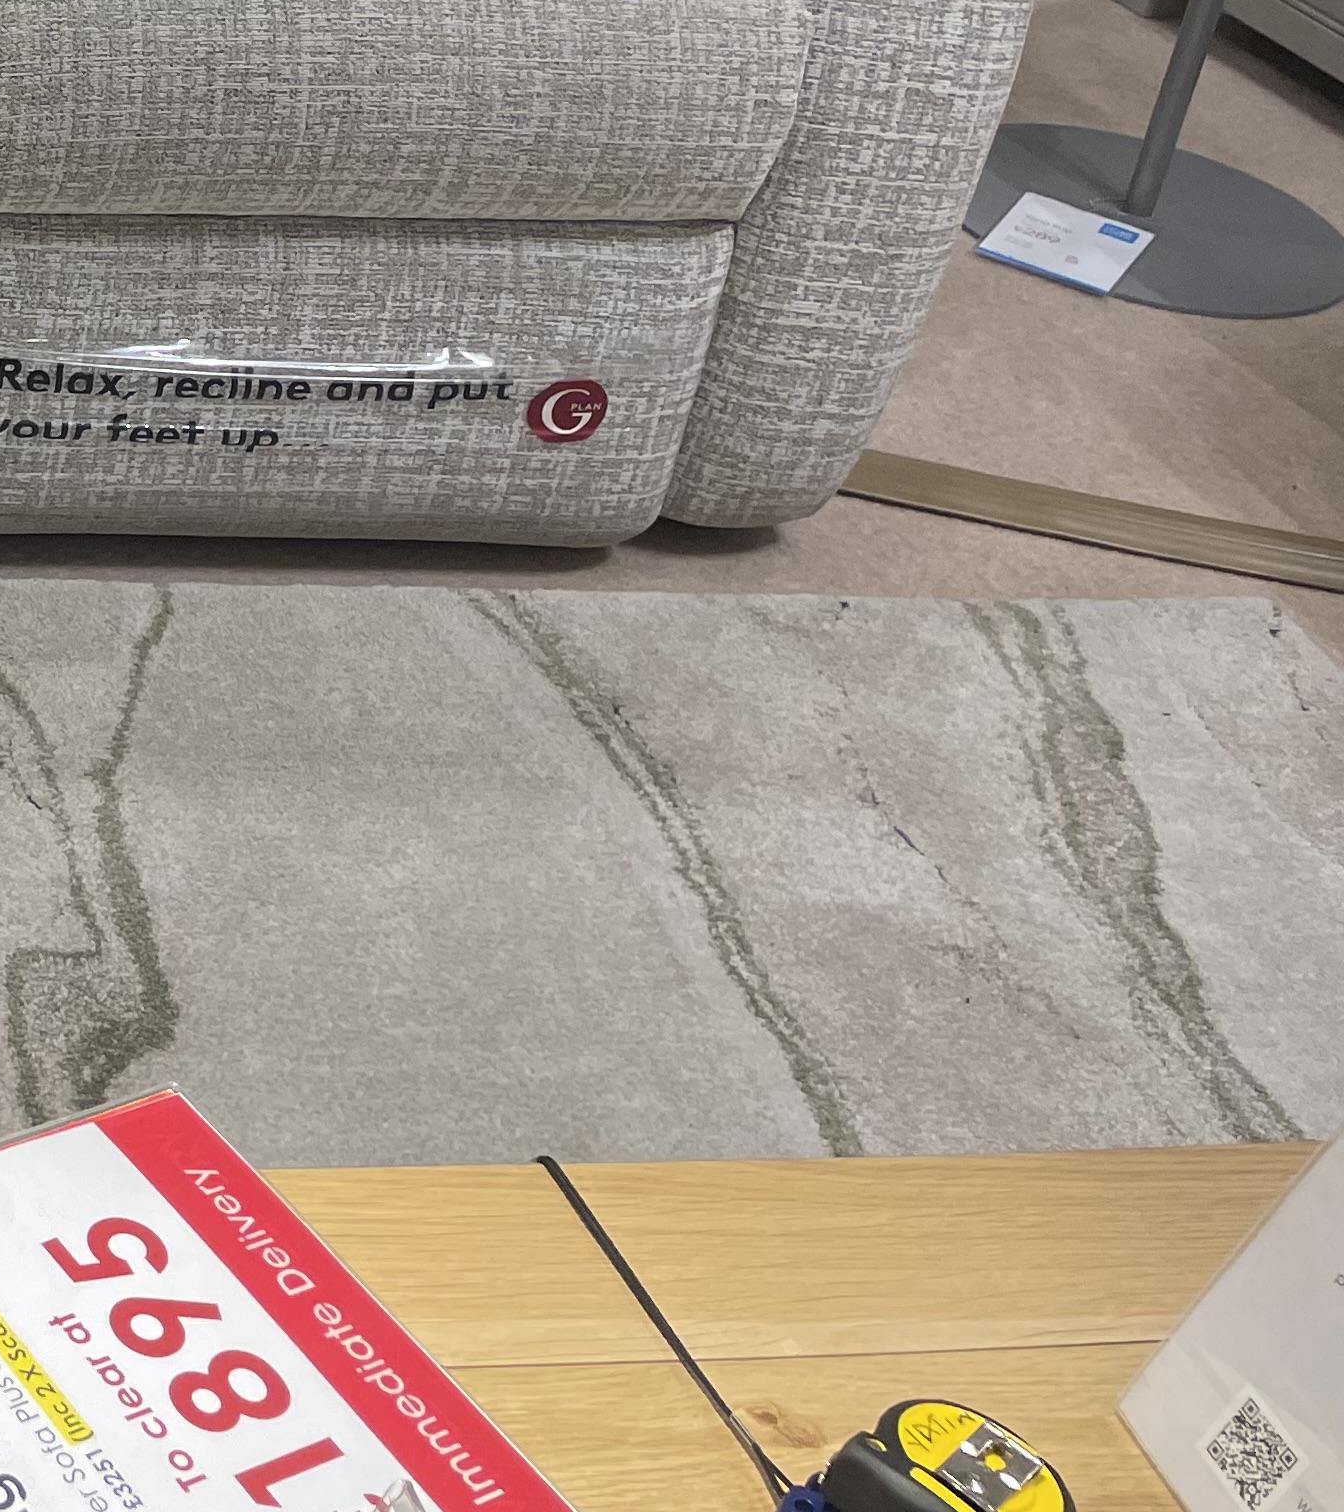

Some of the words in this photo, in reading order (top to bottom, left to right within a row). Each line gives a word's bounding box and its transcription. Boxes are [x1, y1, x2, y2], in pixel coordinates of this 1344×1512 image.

[155, 366, 312, 401] recline
[327, 370, 414, 402] and
[427, 372, 514, 409] put
[570, 402, 602, 411] PLAN
[106, 413, 205, 445] feet
[183, 1168, 316, 1297] Delivery
[48, 1313, 92, 1345] at
[41, 1217, 346, 1508] 1895
[35, 1382, 58, 1398] 2
[86, 1355, 169, 1440] clear
[313, 1302, 505, 1506] Immediate
[53, 1401, 95, 1443] (Inc
[35, 1426, 87, 1484] Sofa
[168, 1449, 208, 1493] To
[85, 1448, 144, 1510] £3251
